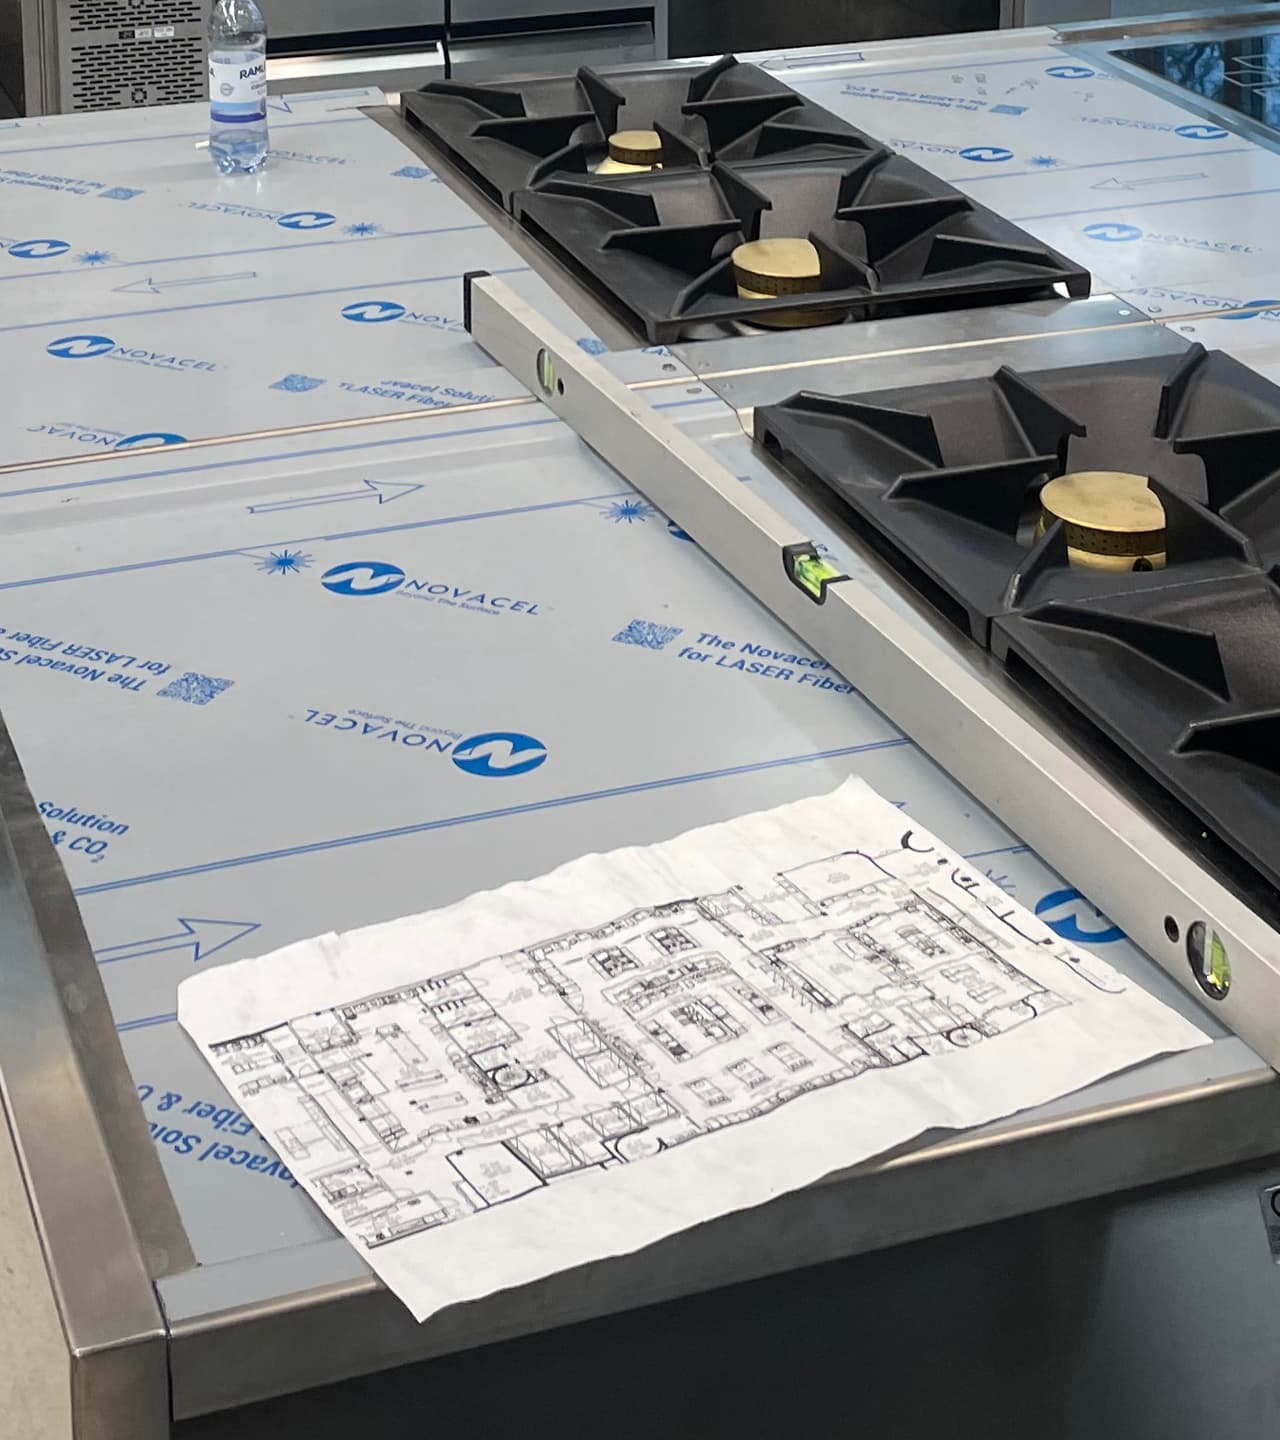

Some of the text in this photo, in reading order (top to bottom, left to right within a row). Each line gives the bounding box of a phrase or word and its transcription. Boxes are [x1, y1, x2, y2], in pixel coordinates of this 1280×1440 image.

[113, 346, 217, 372] NOVACEL
[405, 579, 540, 616] NOVACEL
[6, 630, 64, 652] Fiber
[61, 643, 144, 668] LASER
[696, 631, 736, 651] The
[14, 654, 149, 692] The Novacel
[146, 662, 173, 677] for
[677, 646, 714, 664] for
[715, 655, 795, 682] LASER
[303, 709, 454, 754] NOVACEL
[38, 801, 130, 836] Solution
[156, 1091, 183, 1112] &
[184, 1099, 255, 1137] Fiber
[198, 1140, 300, 1188] ovacel
